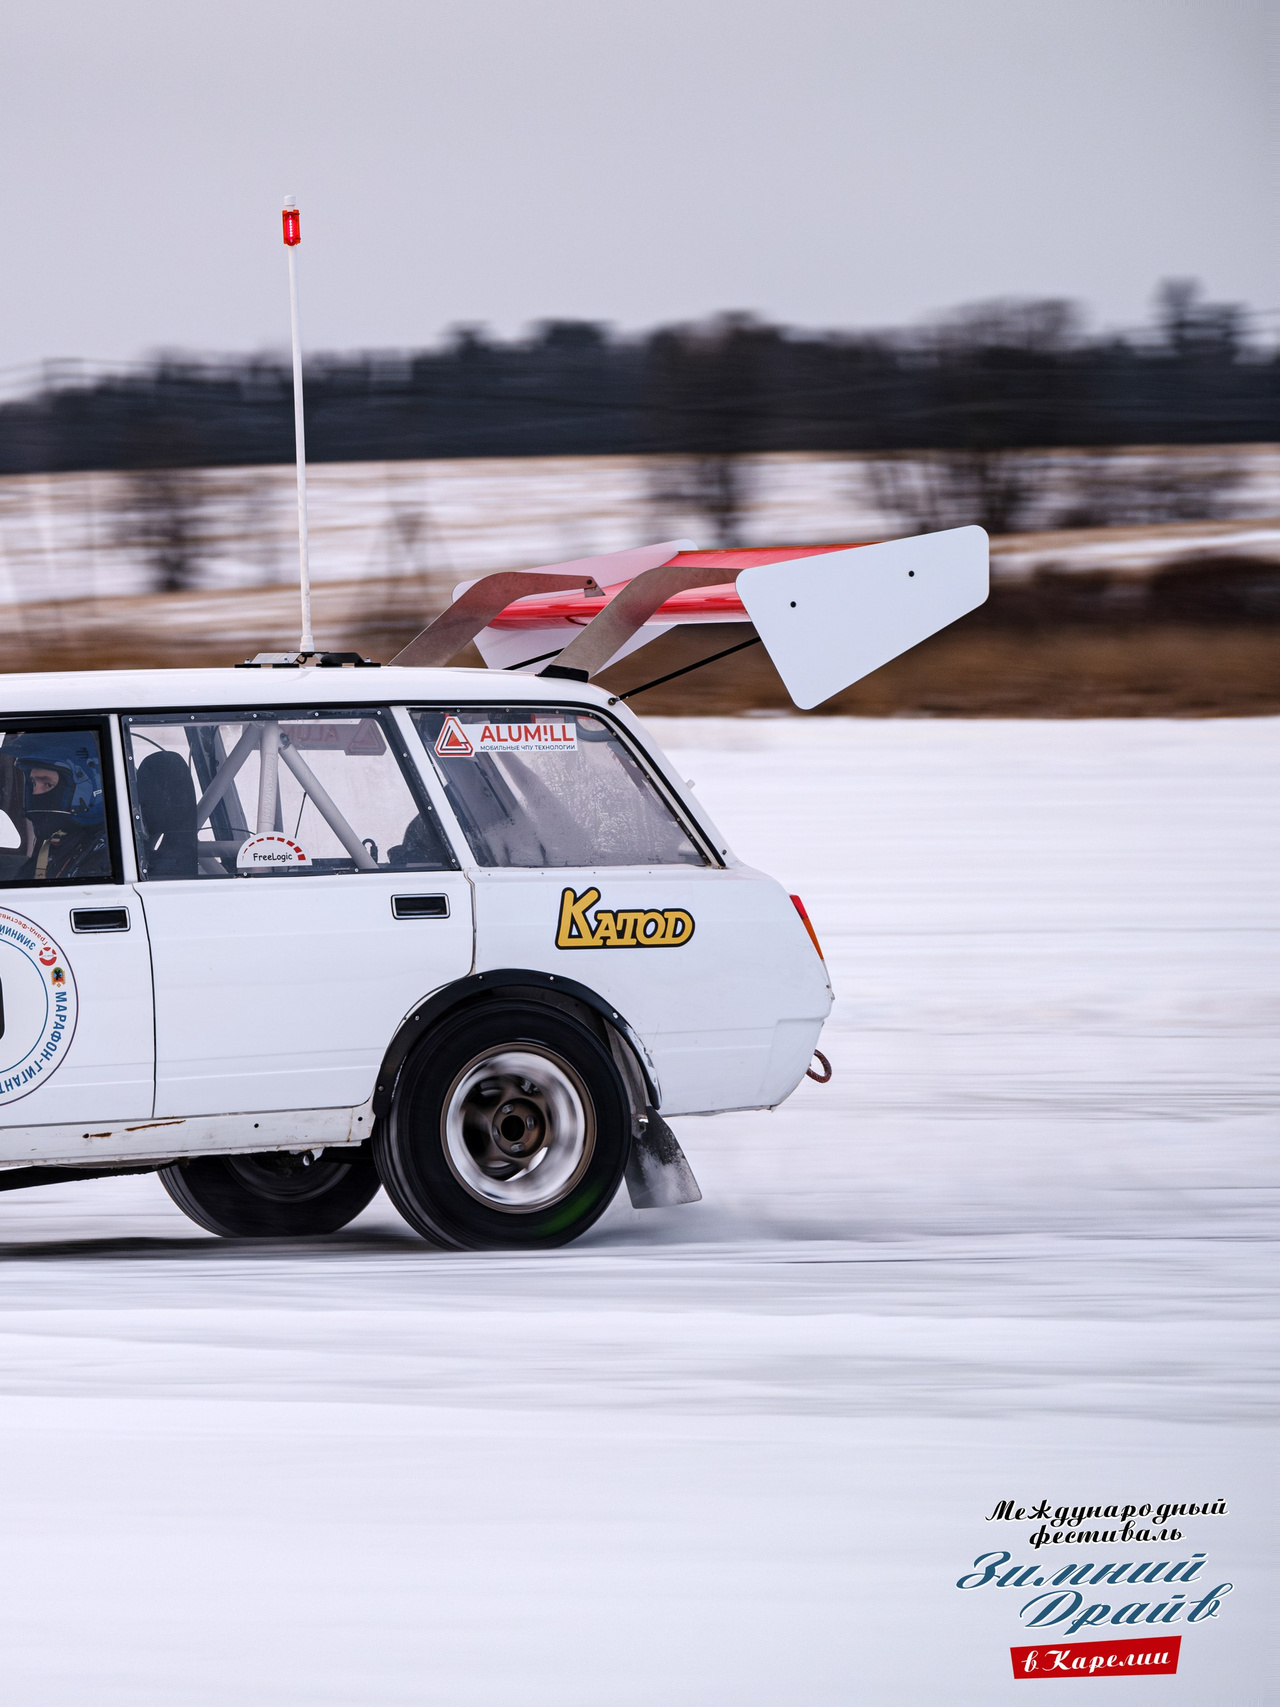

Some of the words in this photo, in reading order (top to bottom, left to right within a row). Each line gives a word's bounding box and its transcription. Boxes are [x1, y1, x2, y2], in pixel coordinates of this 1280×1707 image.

[480, 725, 574, 742] ALUM!LL
[253, 852, 292, 862] FreeLogic
[0, 924, 36, 950] ЗИМНИЙ
